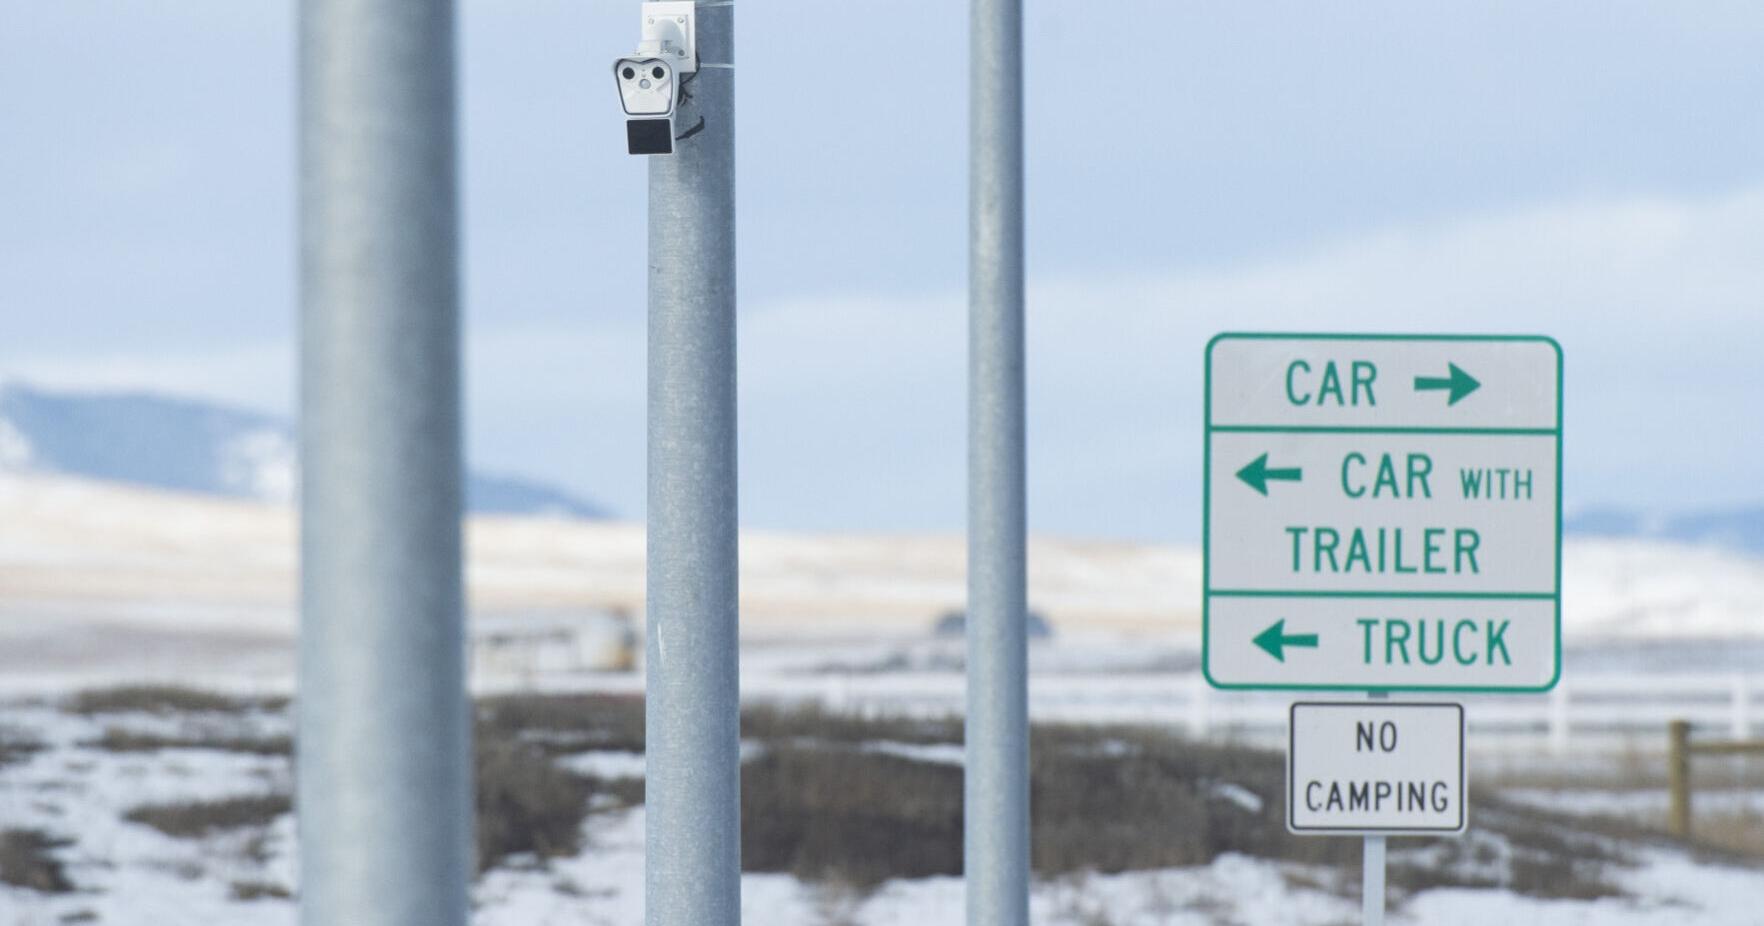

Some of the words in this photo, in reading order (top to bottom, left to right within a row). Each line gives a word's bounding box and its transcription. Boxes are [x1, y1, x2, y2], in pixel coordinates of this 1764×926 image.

[1284, 359, 1378, 406] CAR
[1340, 451, 1434, 499] CAR
[1460, 468, 1534, 500] WITH
[1284, 526, 1481, 574] TRAILER
[1356, 618, 1512, 667] TRUCK
[1356, 721, 1397, 752] NO
[1305, 780, 1448, 812] CAMPING
